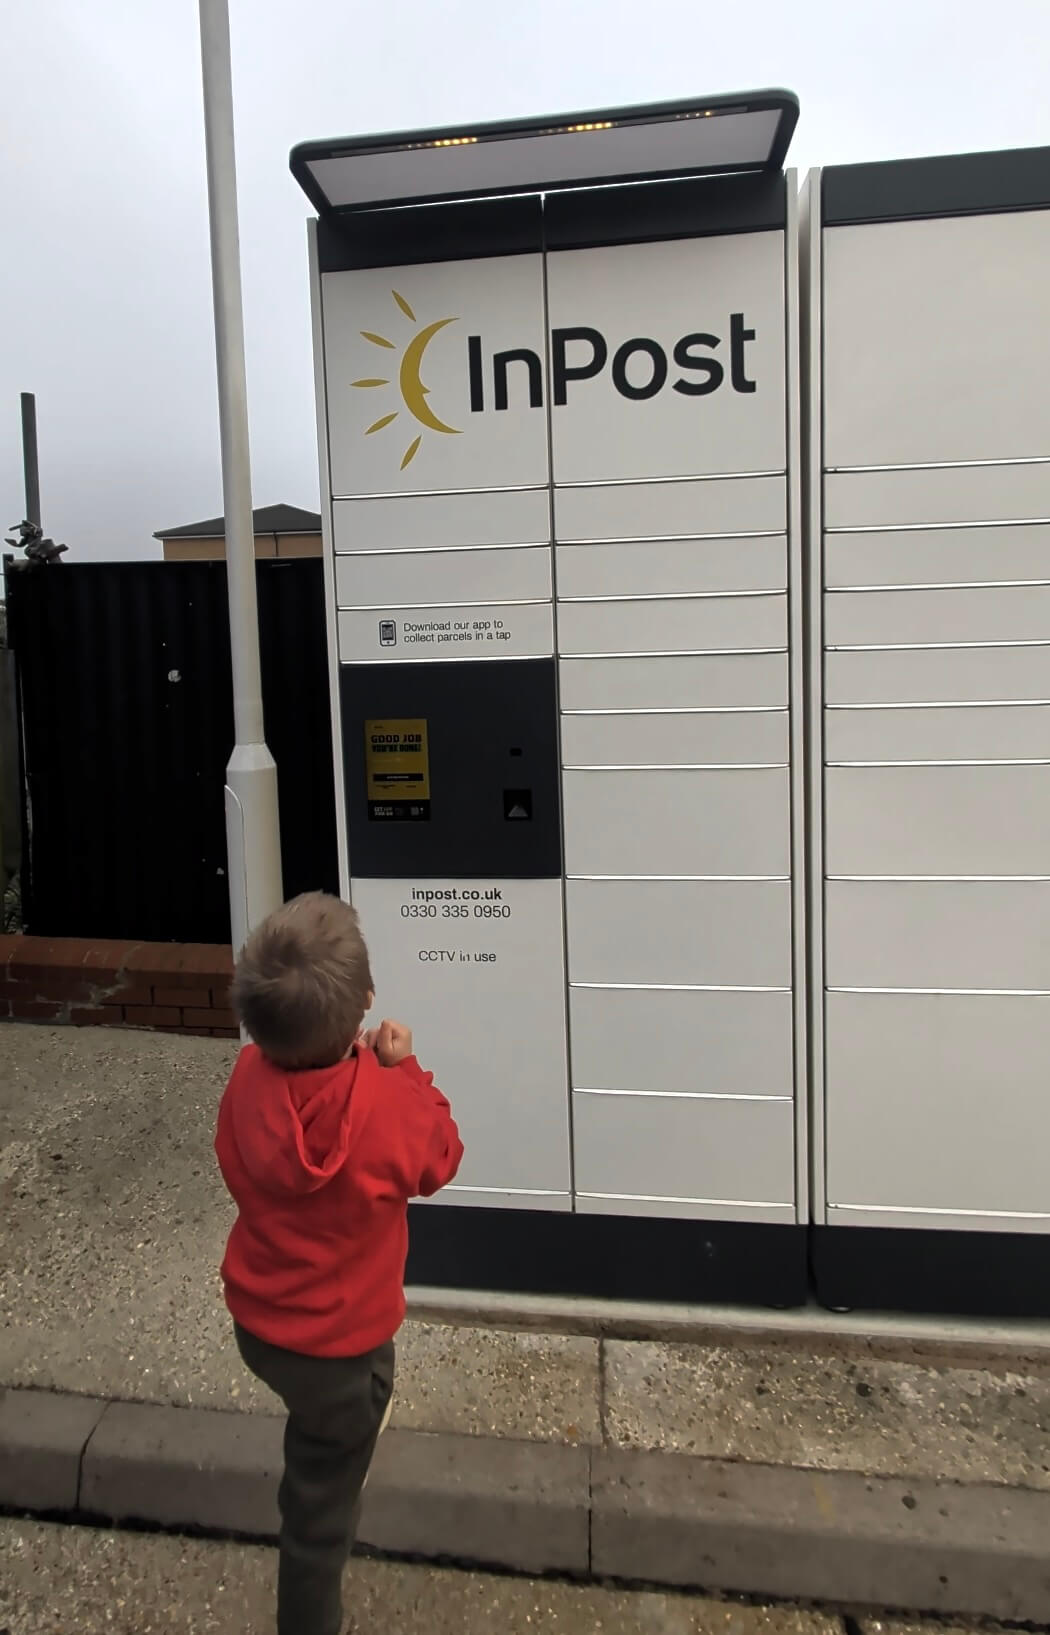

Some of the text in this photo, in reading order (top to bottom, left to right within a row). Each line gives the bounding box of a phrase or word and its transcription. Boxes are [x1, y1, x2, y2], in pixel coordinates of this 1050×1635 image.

[468, 313, 757, 412] InPost
[403, 619, 503, 632] Download our app to
[403, 632, 435, 643] collect
[437, 631, 472, 643] parcels
[475, 631, 484, 641] in
[495, 631, 511, 641] tap
[371, 734, 422, 743] GOOD JOB
[411, 887, 502, 902] inpost.co.uk
[400, 905, 511, 918] 0330 335 0950
[418, 950, 497, 962] CCTV in use
